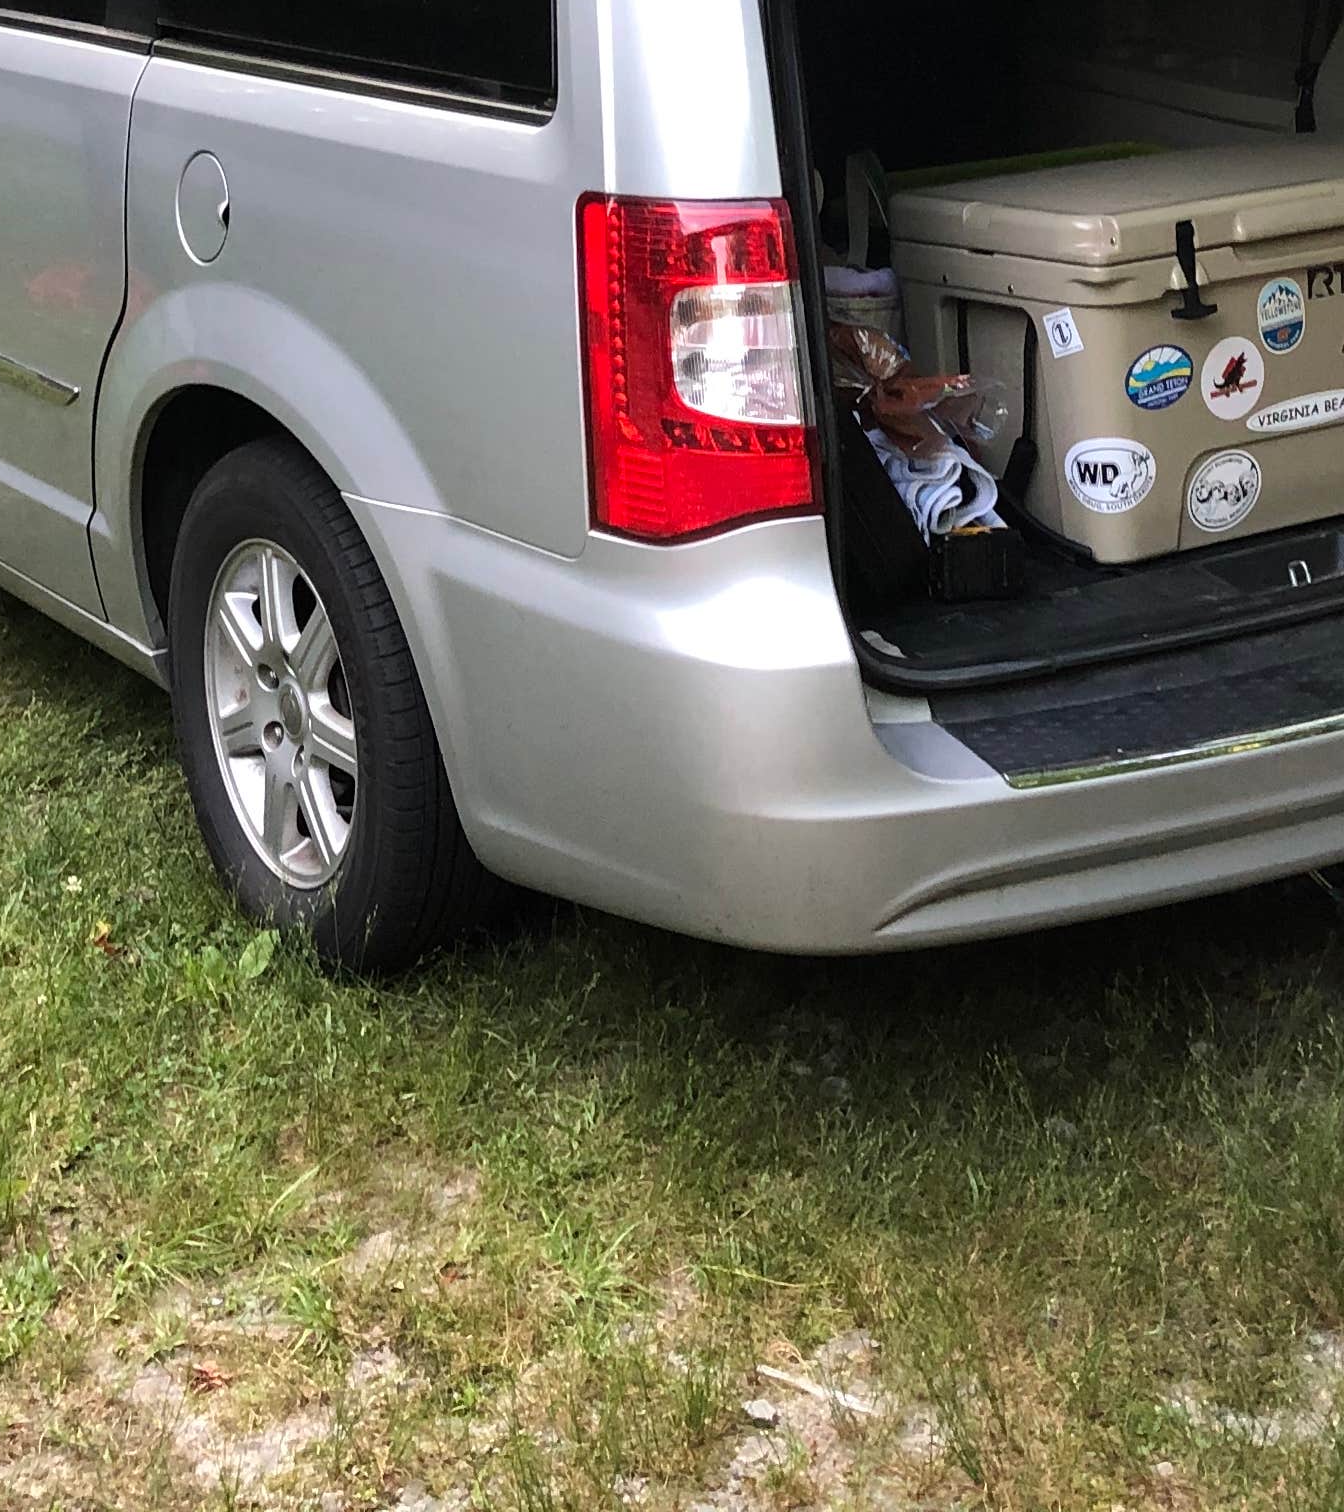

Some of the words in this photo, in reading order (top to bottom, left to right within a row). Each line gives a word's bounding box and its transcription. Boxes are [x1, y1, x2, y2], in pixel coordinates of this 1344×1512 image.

[1261, 301, 1302, 321] YELLOWSTONE
[1138, 382, 1165, 399] GRAND
[1165, 376, 1188, 390] TETON
[1258, 403, 1319, 427] VIRGINIA
[1076, 461, 1119, 485] WD
[1106, 499, 1133, 511] SOUTH
